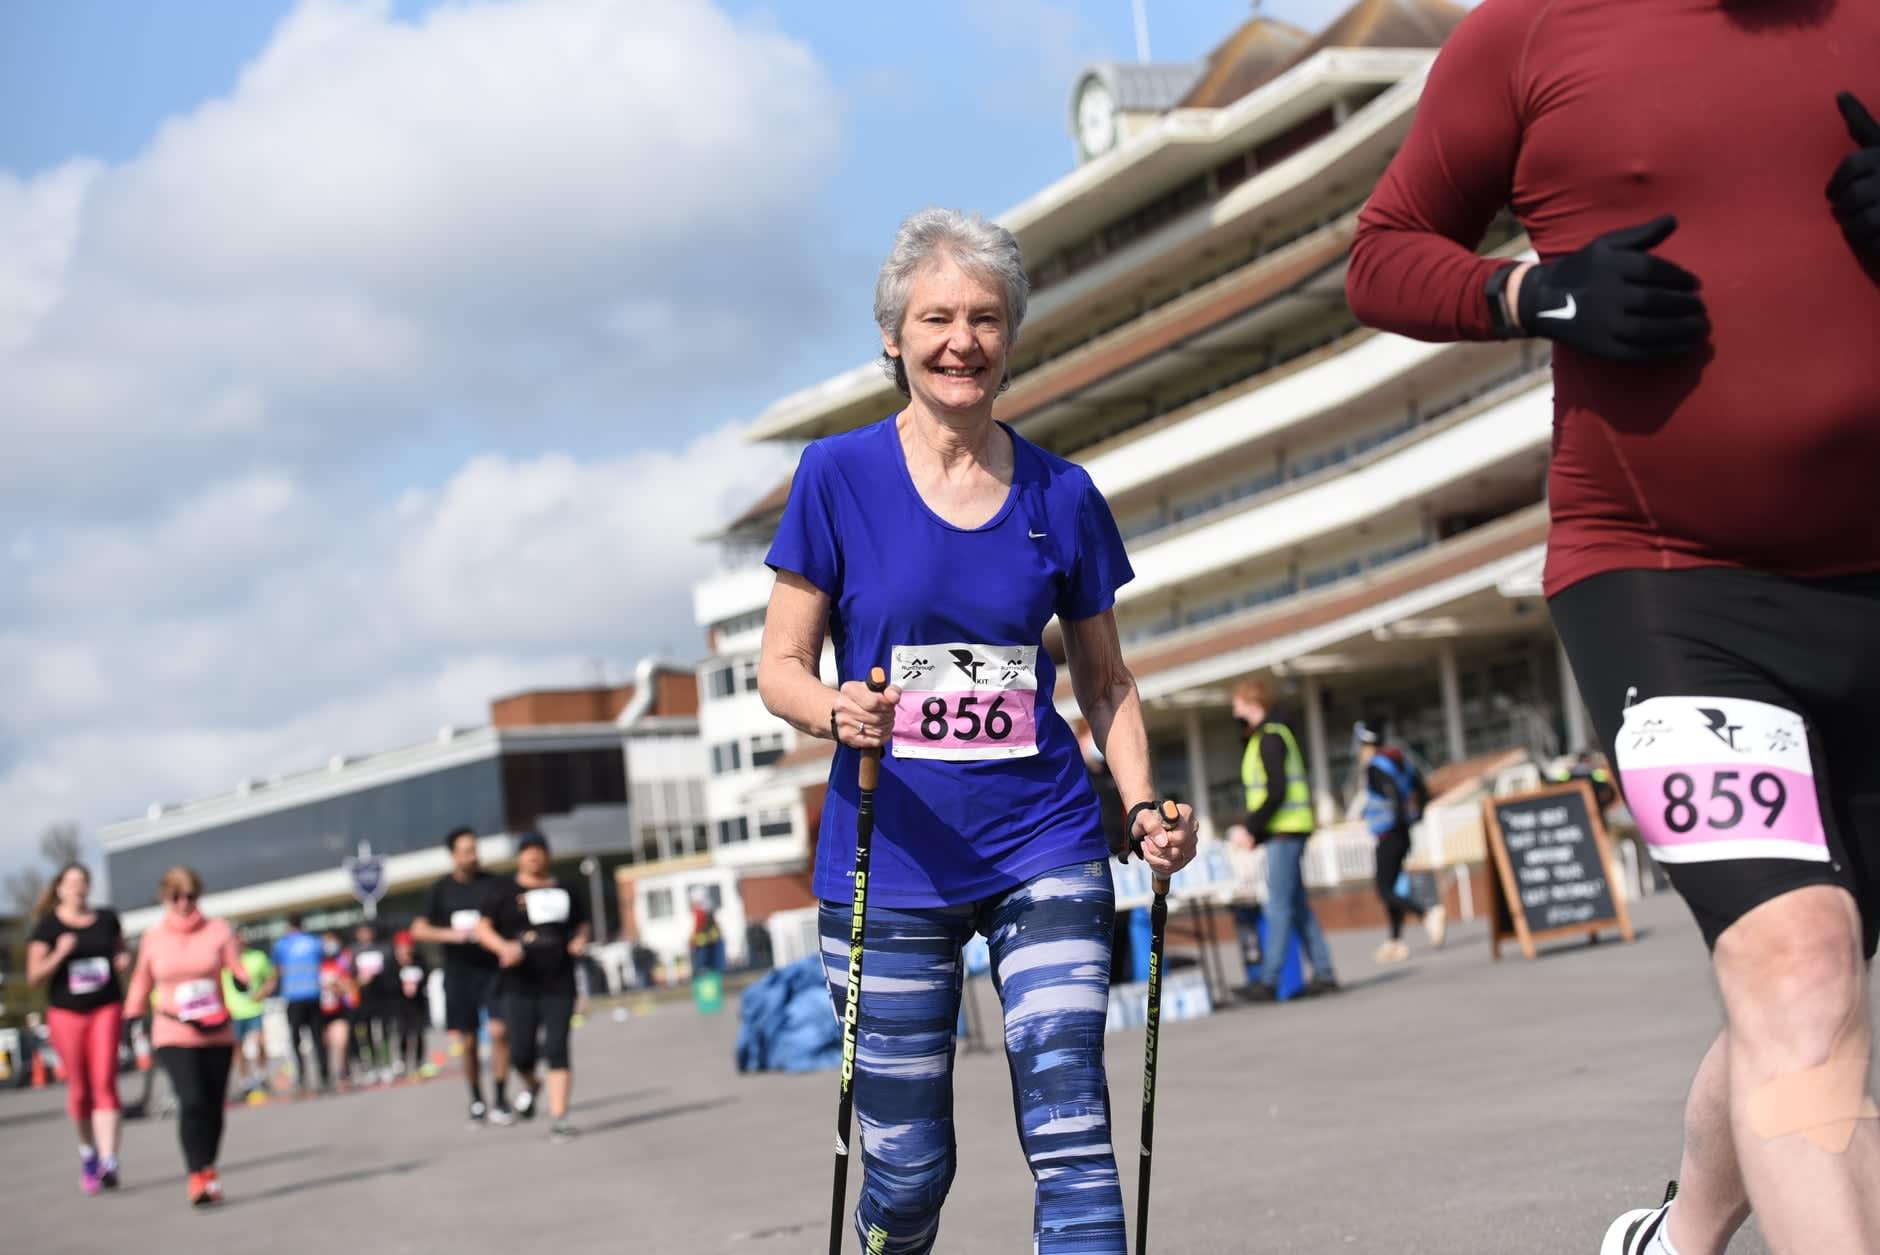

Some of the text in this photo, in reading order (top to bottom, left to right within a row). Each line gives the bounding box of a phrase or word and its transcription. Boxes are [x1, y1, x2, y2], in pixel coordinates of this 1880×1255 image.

[920, 696, 1013, 741] 856
[1663, 771, 1787, 833] 859
[851, 871, 866, 939] GABEL
